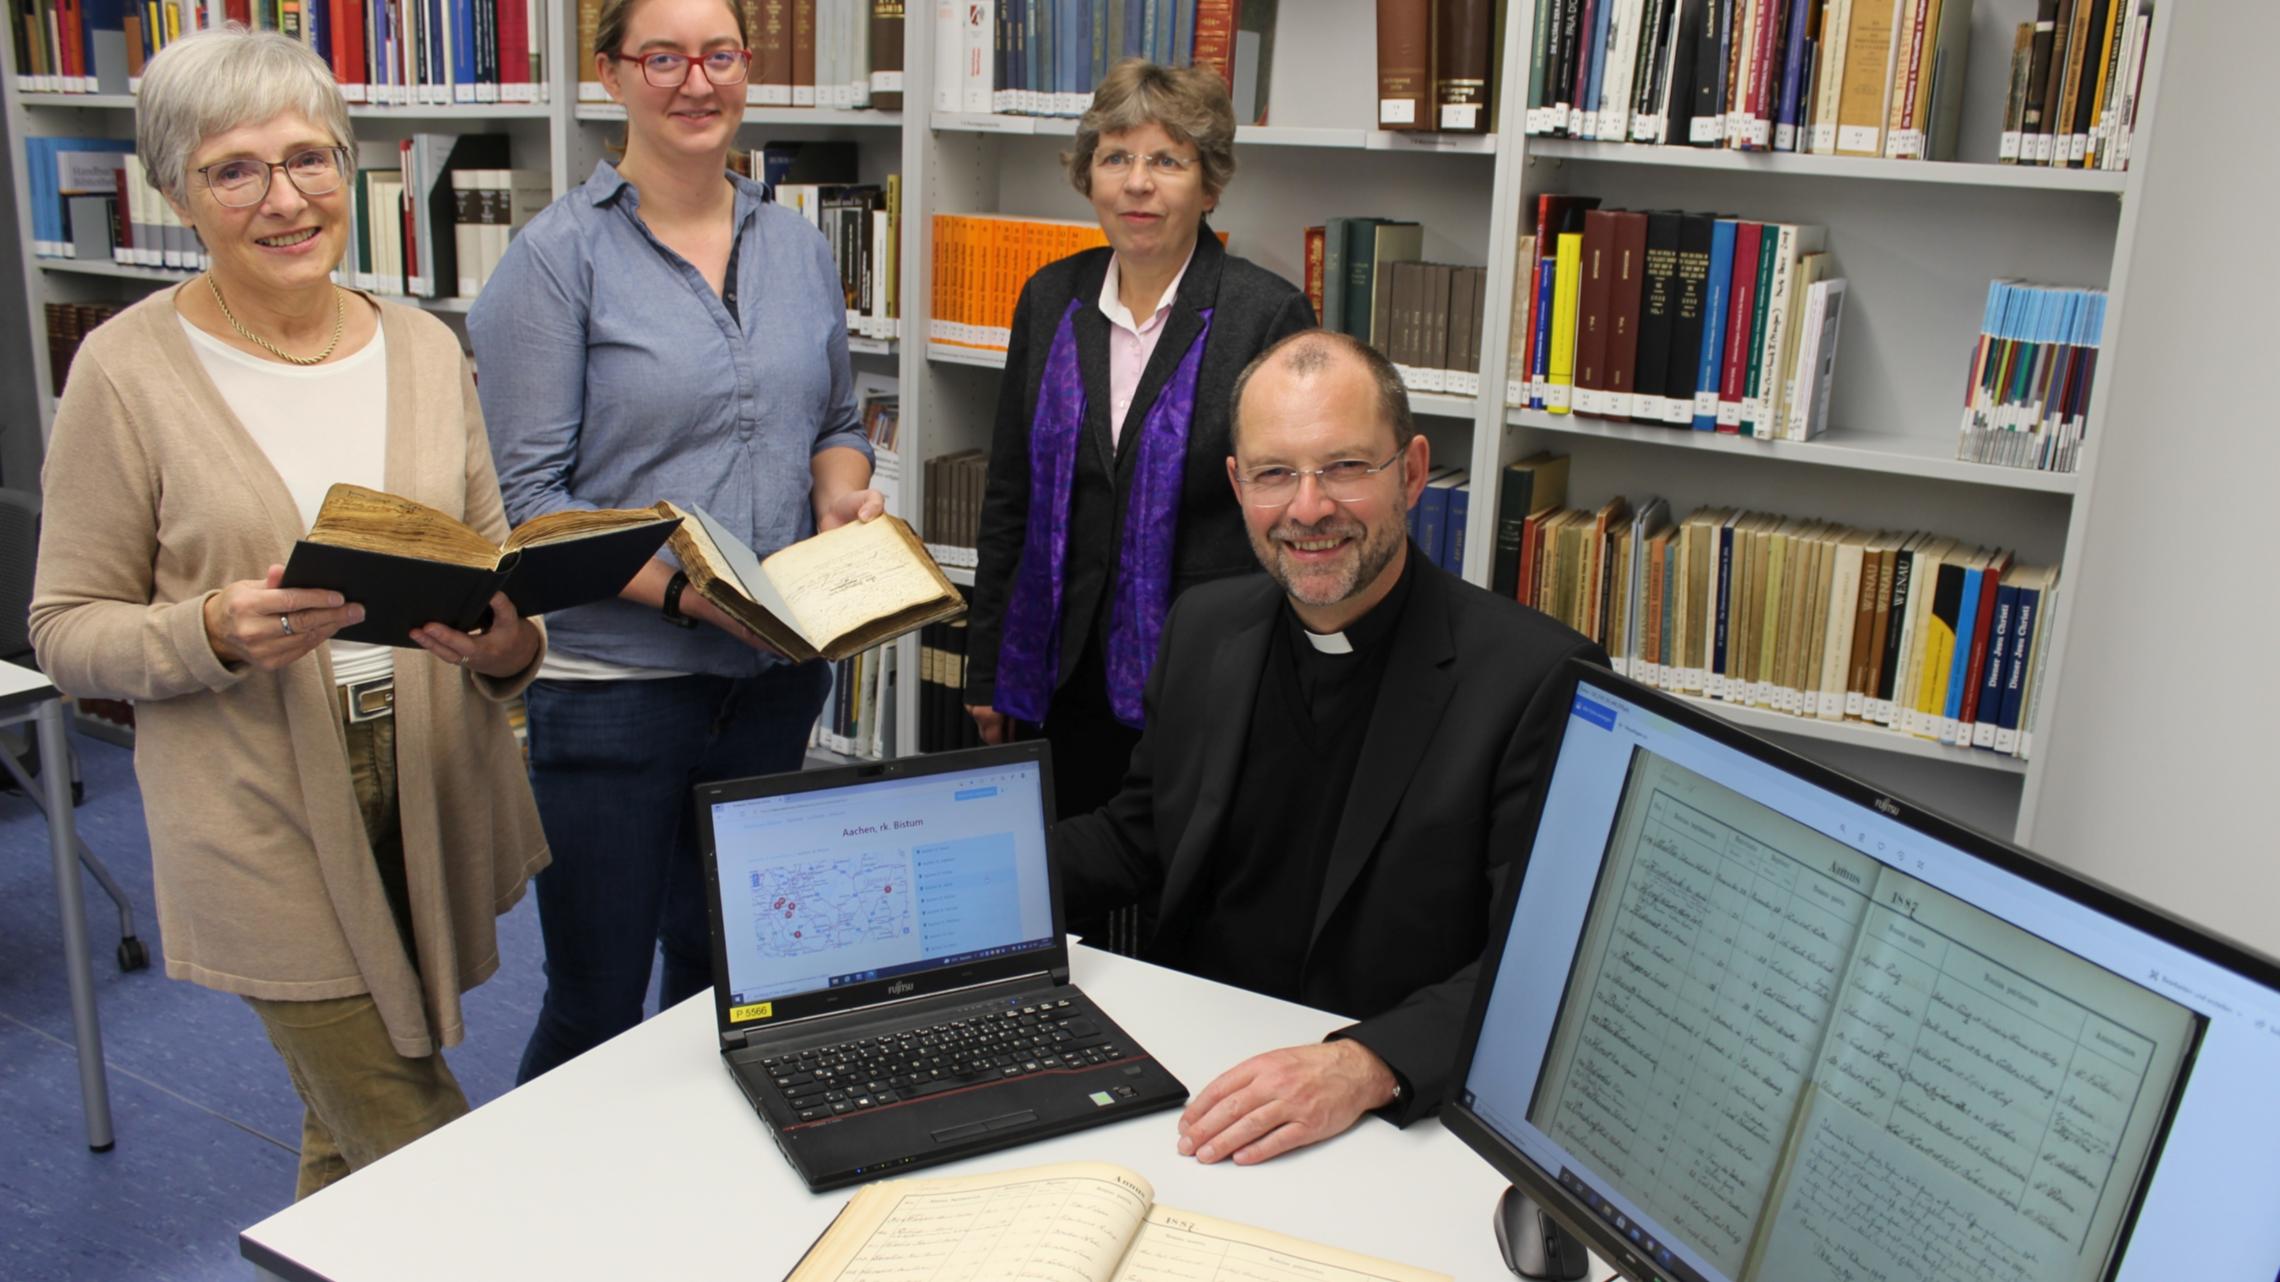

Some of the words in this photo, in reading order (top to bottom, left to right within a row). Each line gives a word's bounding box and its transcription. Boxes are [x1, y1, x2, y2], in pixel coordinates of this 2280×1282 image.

[1862, 564, 1878, 613] WENAU
[1876, 566, 1893, 614] WENAU
[1892, 560, 1910, 607] WENAU
[1997, 604, 2010, 635] Christi
[2018, 605, 2031, 636] Christi
[1993, 636, 2004, 657] Jesu
[2014, 637, 2025, 658] Jesu
[1988, 657, 2001, 688] Diener
[2008, 659, 2022, 690] Diener
[842, 825, 878, 838] Aachen,
[879, 820, 890, 832] rk.
[893, 817, 924, 830] Bistum
[888, 980, 914, 994] FUJITSU
[736, 1010, 743, 1019] P
[745, 1006, 767, 1018] 5566
